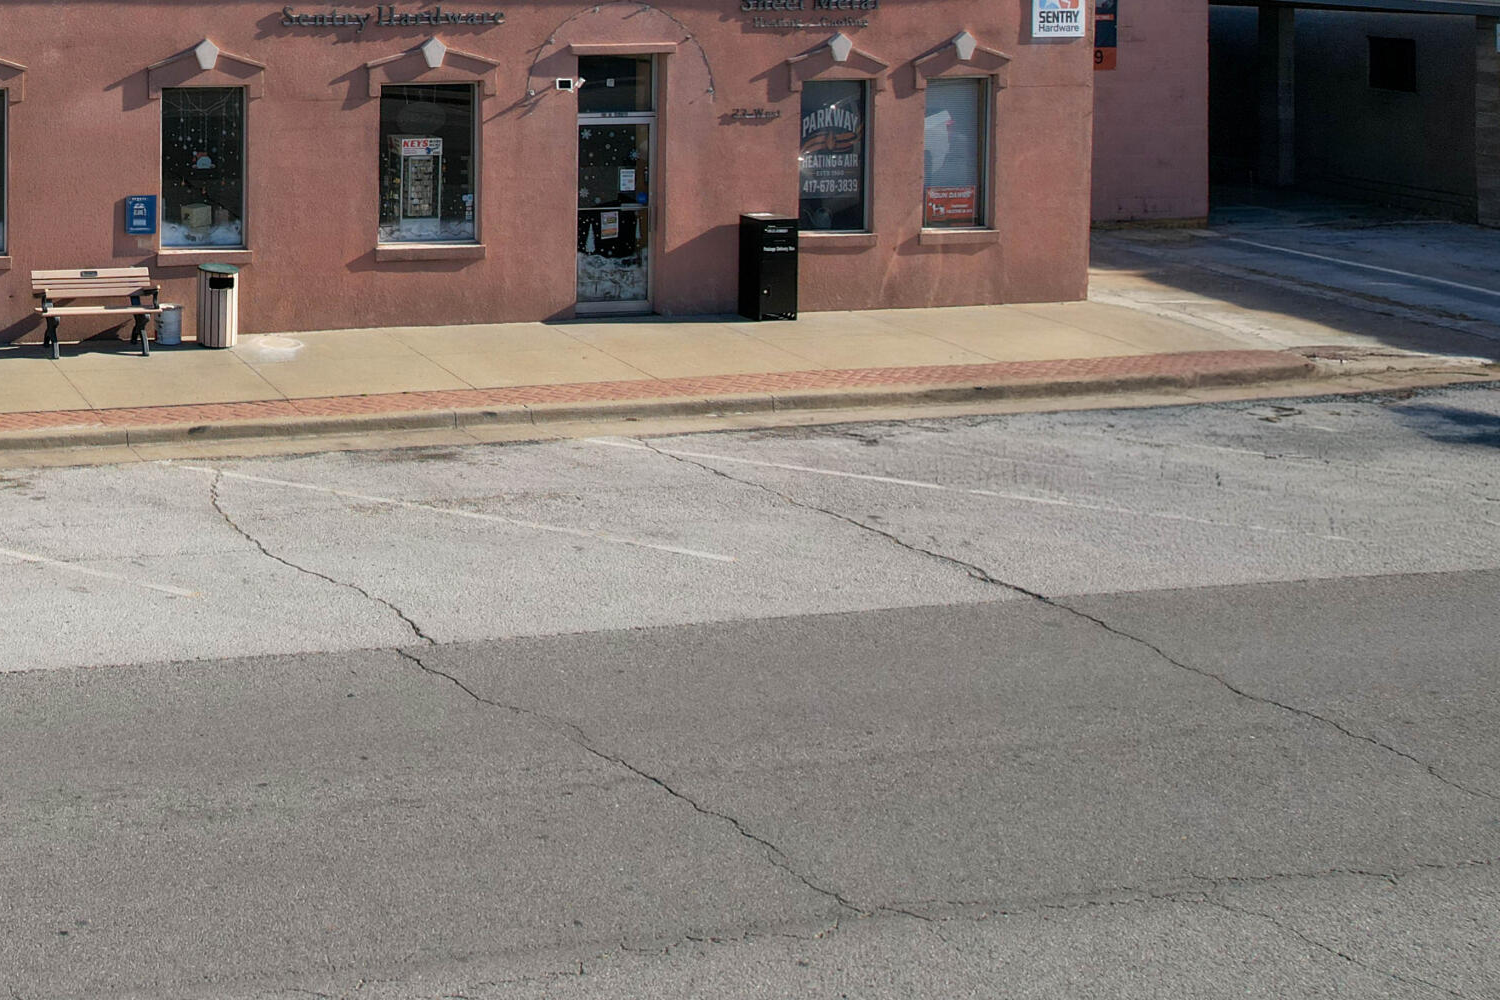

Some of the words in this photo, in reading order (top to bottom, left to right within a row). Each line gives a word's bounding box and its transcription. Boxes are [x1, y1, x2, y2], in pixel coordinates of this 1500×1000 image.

[282, 5, 370, 33] Sentry
[376, 4, 506, 27] Hardware
[1039, 11, 1079, 23] SENTRY
[1039, 24, 1079, 32] Hardware
[802, 108, 858, 137] PARKWAY
[403, 140, 429, 148] KEYS
[802, 153, 836, 168] HEATING
[837, 155, 843, 167] &
[844, 153, 858, 168] AIR
[803, 179, 858, 193] 417-678-3839
